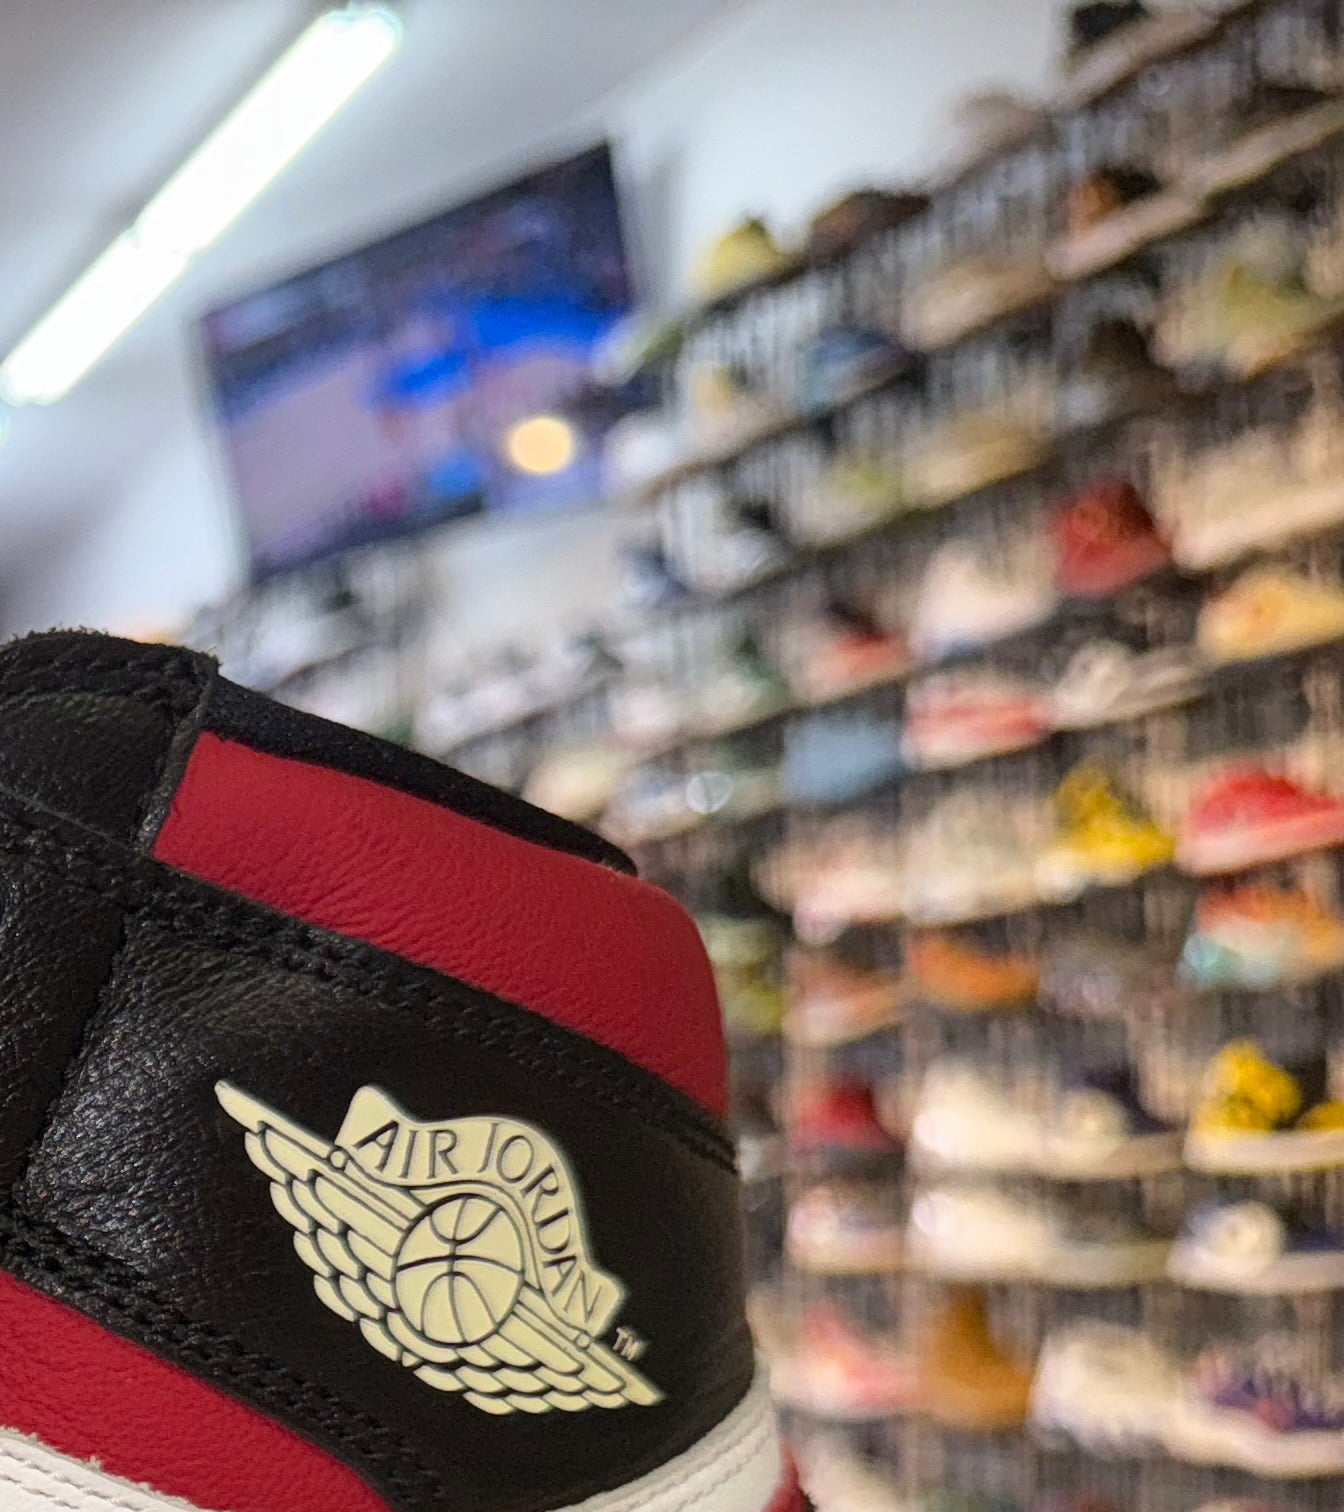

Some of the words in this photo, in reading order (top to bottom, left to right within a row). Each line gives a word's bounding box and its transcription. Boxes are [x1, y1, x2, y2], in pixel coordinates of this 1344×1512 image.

[352, 1119, 461, 1180] AIR
[477, 1122, 604, 1324] JORDAN
[614, 1327, 642, 1361] TM
